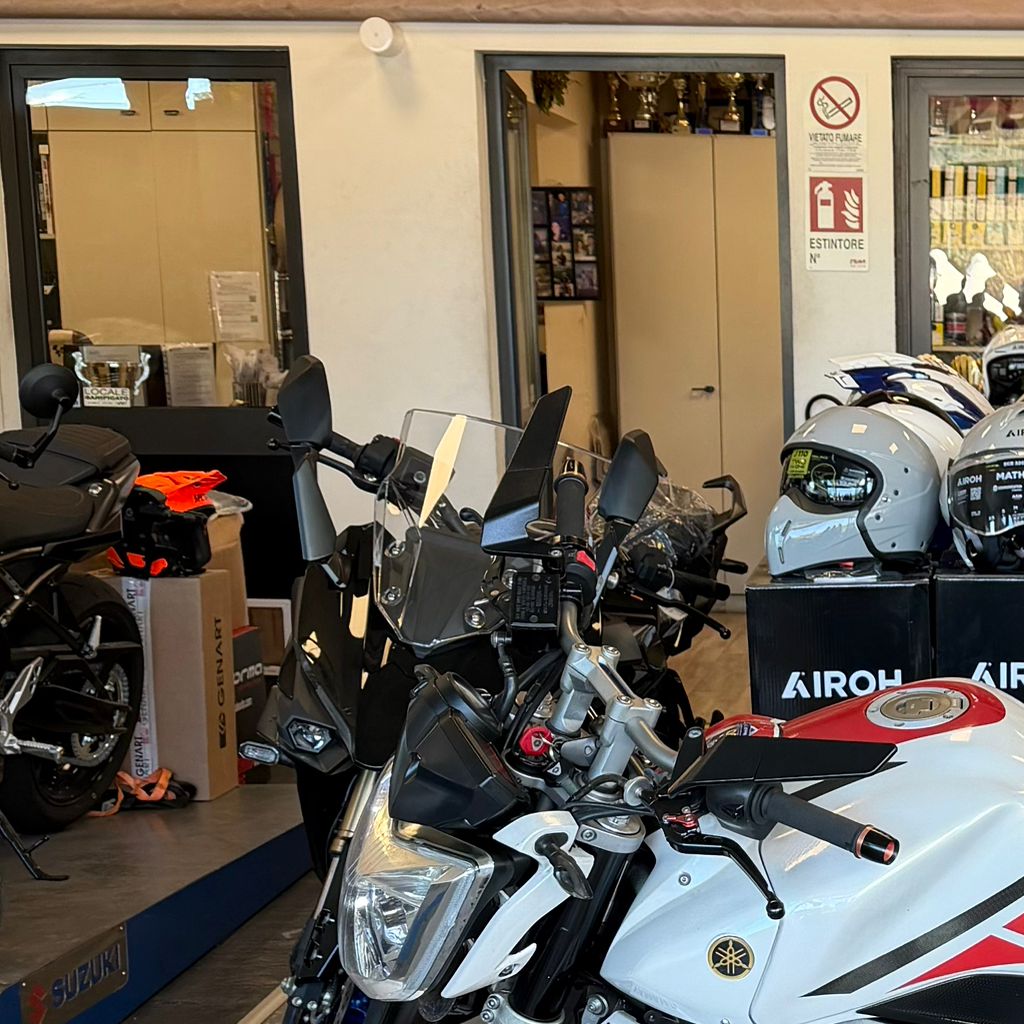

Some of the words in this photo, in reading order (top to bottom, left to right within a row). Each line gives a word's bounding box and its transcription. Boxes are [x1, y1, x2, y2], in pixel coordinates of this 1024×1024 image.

[809, 133, 834, 143] VIETATO
[836, 133, 862, 143] FUMARE
[809, 238, 865, 250] ESTINTORE
[957, 474, 983, 487] AIROH
[214, 617, 226, 707] GENART
[781, 669, 902, 699] AIROH
[51, 943, 121, 1009] SUZUKI
